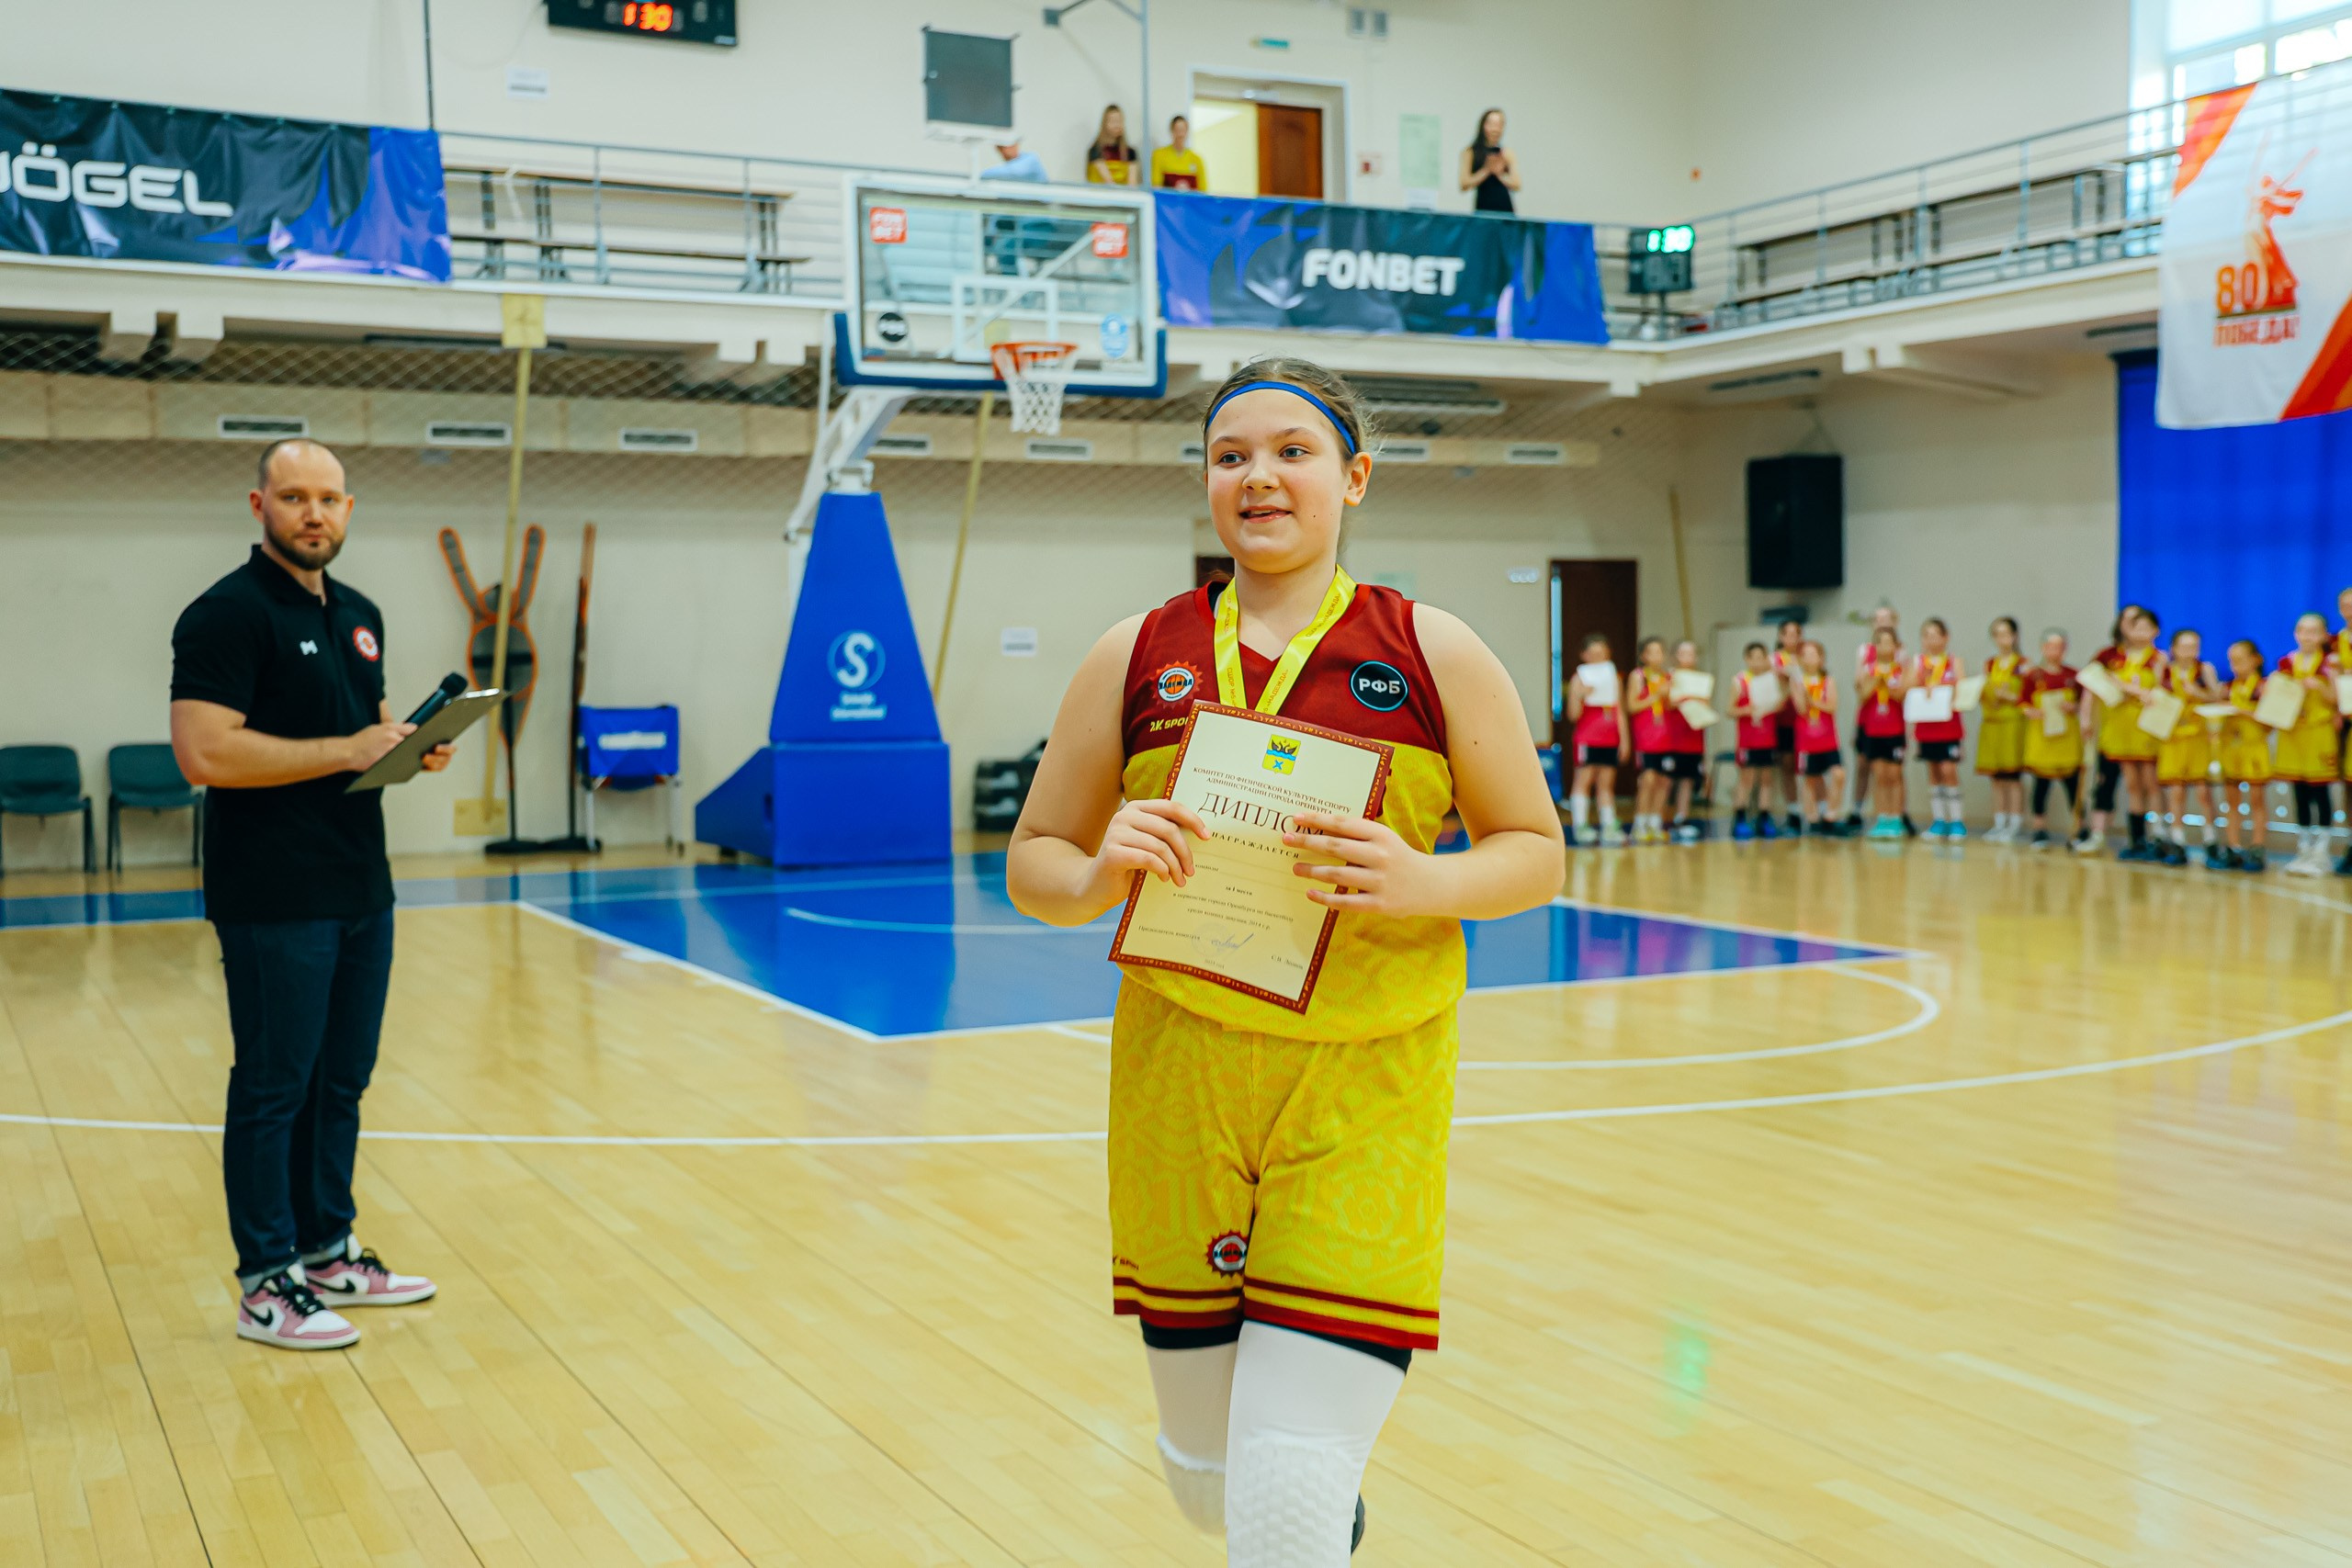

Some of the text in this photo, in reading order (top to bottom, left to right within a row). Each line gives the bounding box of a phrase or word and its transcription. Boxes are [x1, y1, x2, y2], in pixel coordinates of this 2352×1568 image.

[1302, 248, 1465, 296] FONBET
[1359, 678, 1400, 694] РФБ
[1193, 766, 1224, 778] КОМИТЕТ
[1235, 776, 1283, 793] ФИЗИЧЕСКОЙ
[1283, 788, 1317, 803] КУЛЬТУРЕ
[1324, 801, 1351, 813] СПОРТУ
[1206, 776, 1332, 814] АДМИНИСТРАЦИИ ГОРОДА ОРЕНБУРГА
[1212, 831, 1299, 859] НАГРАЖДАЕТСЯ
